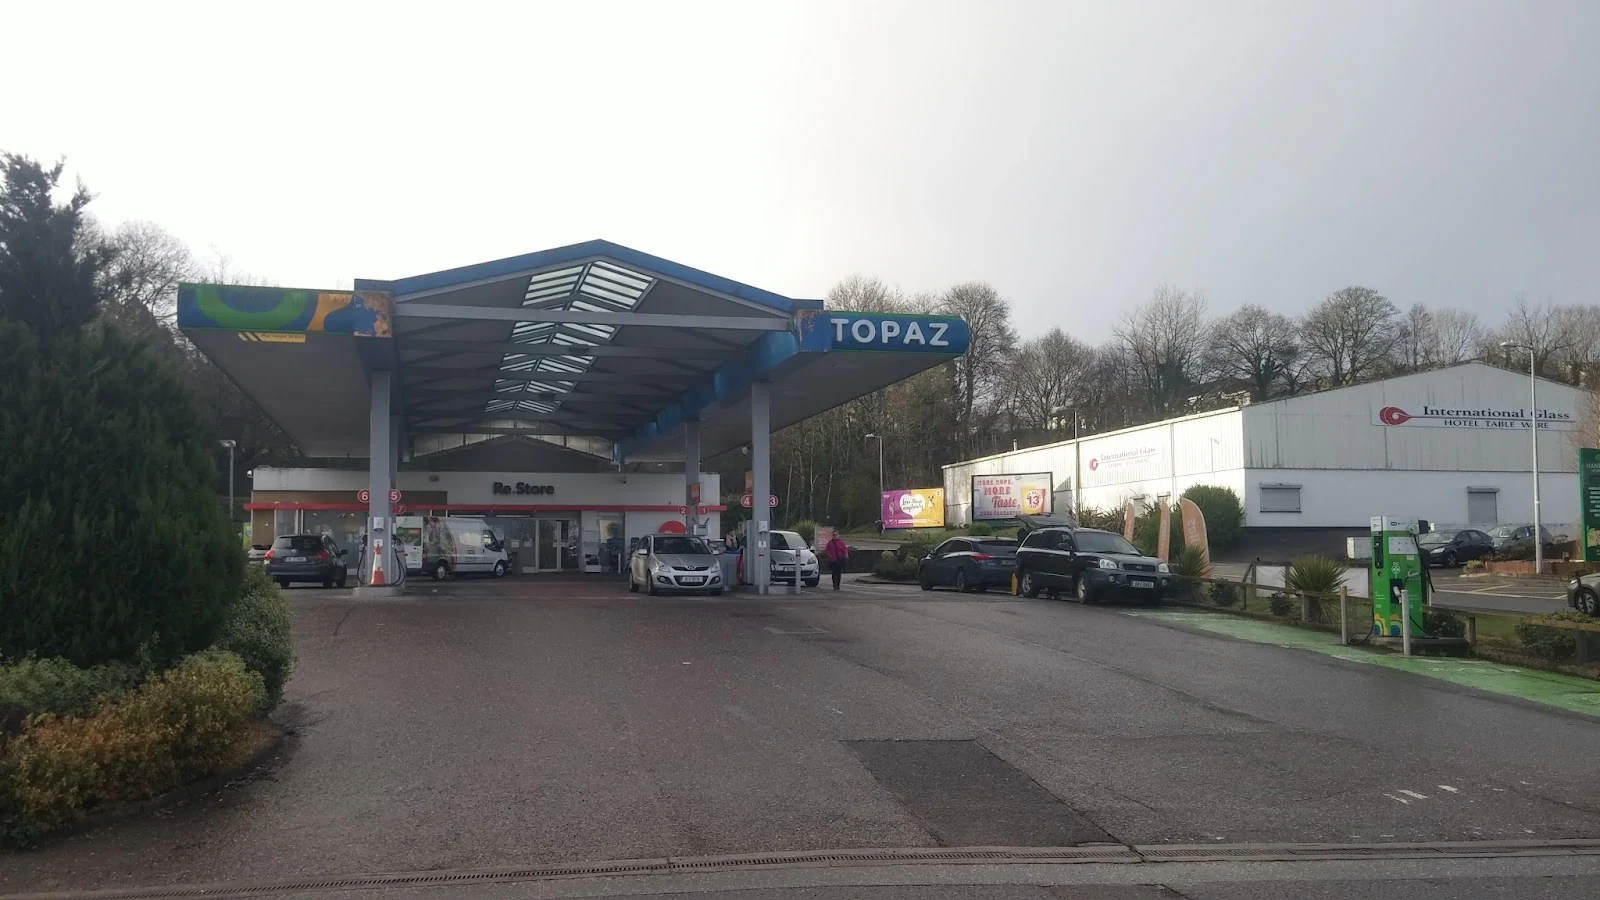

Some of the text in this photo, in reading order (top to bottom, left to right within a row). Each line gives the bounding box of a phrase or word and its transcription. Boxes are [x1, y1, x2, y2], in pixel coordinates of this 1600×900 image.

[830, 318, 950, 346] TOPAZ
[1423, 405, 1570, 419] International Glass
[1444, 419, 1479, 427] HOTEL
[1485, 420, 1516, 428] TABLE
[493, 481, 555, 495] Re.Store
[984, 486, 1011, 495] MORE
[361, 491, 369, 501] 6
[391, 491, 398, 501] 5
[1029, 495, 1040, 506] 13
[743, 497, 750, 505] 4
[769, 497, 776, 505] 3
[398, 505, 404, 513] 7
[681, 506, 686, 514] 2
